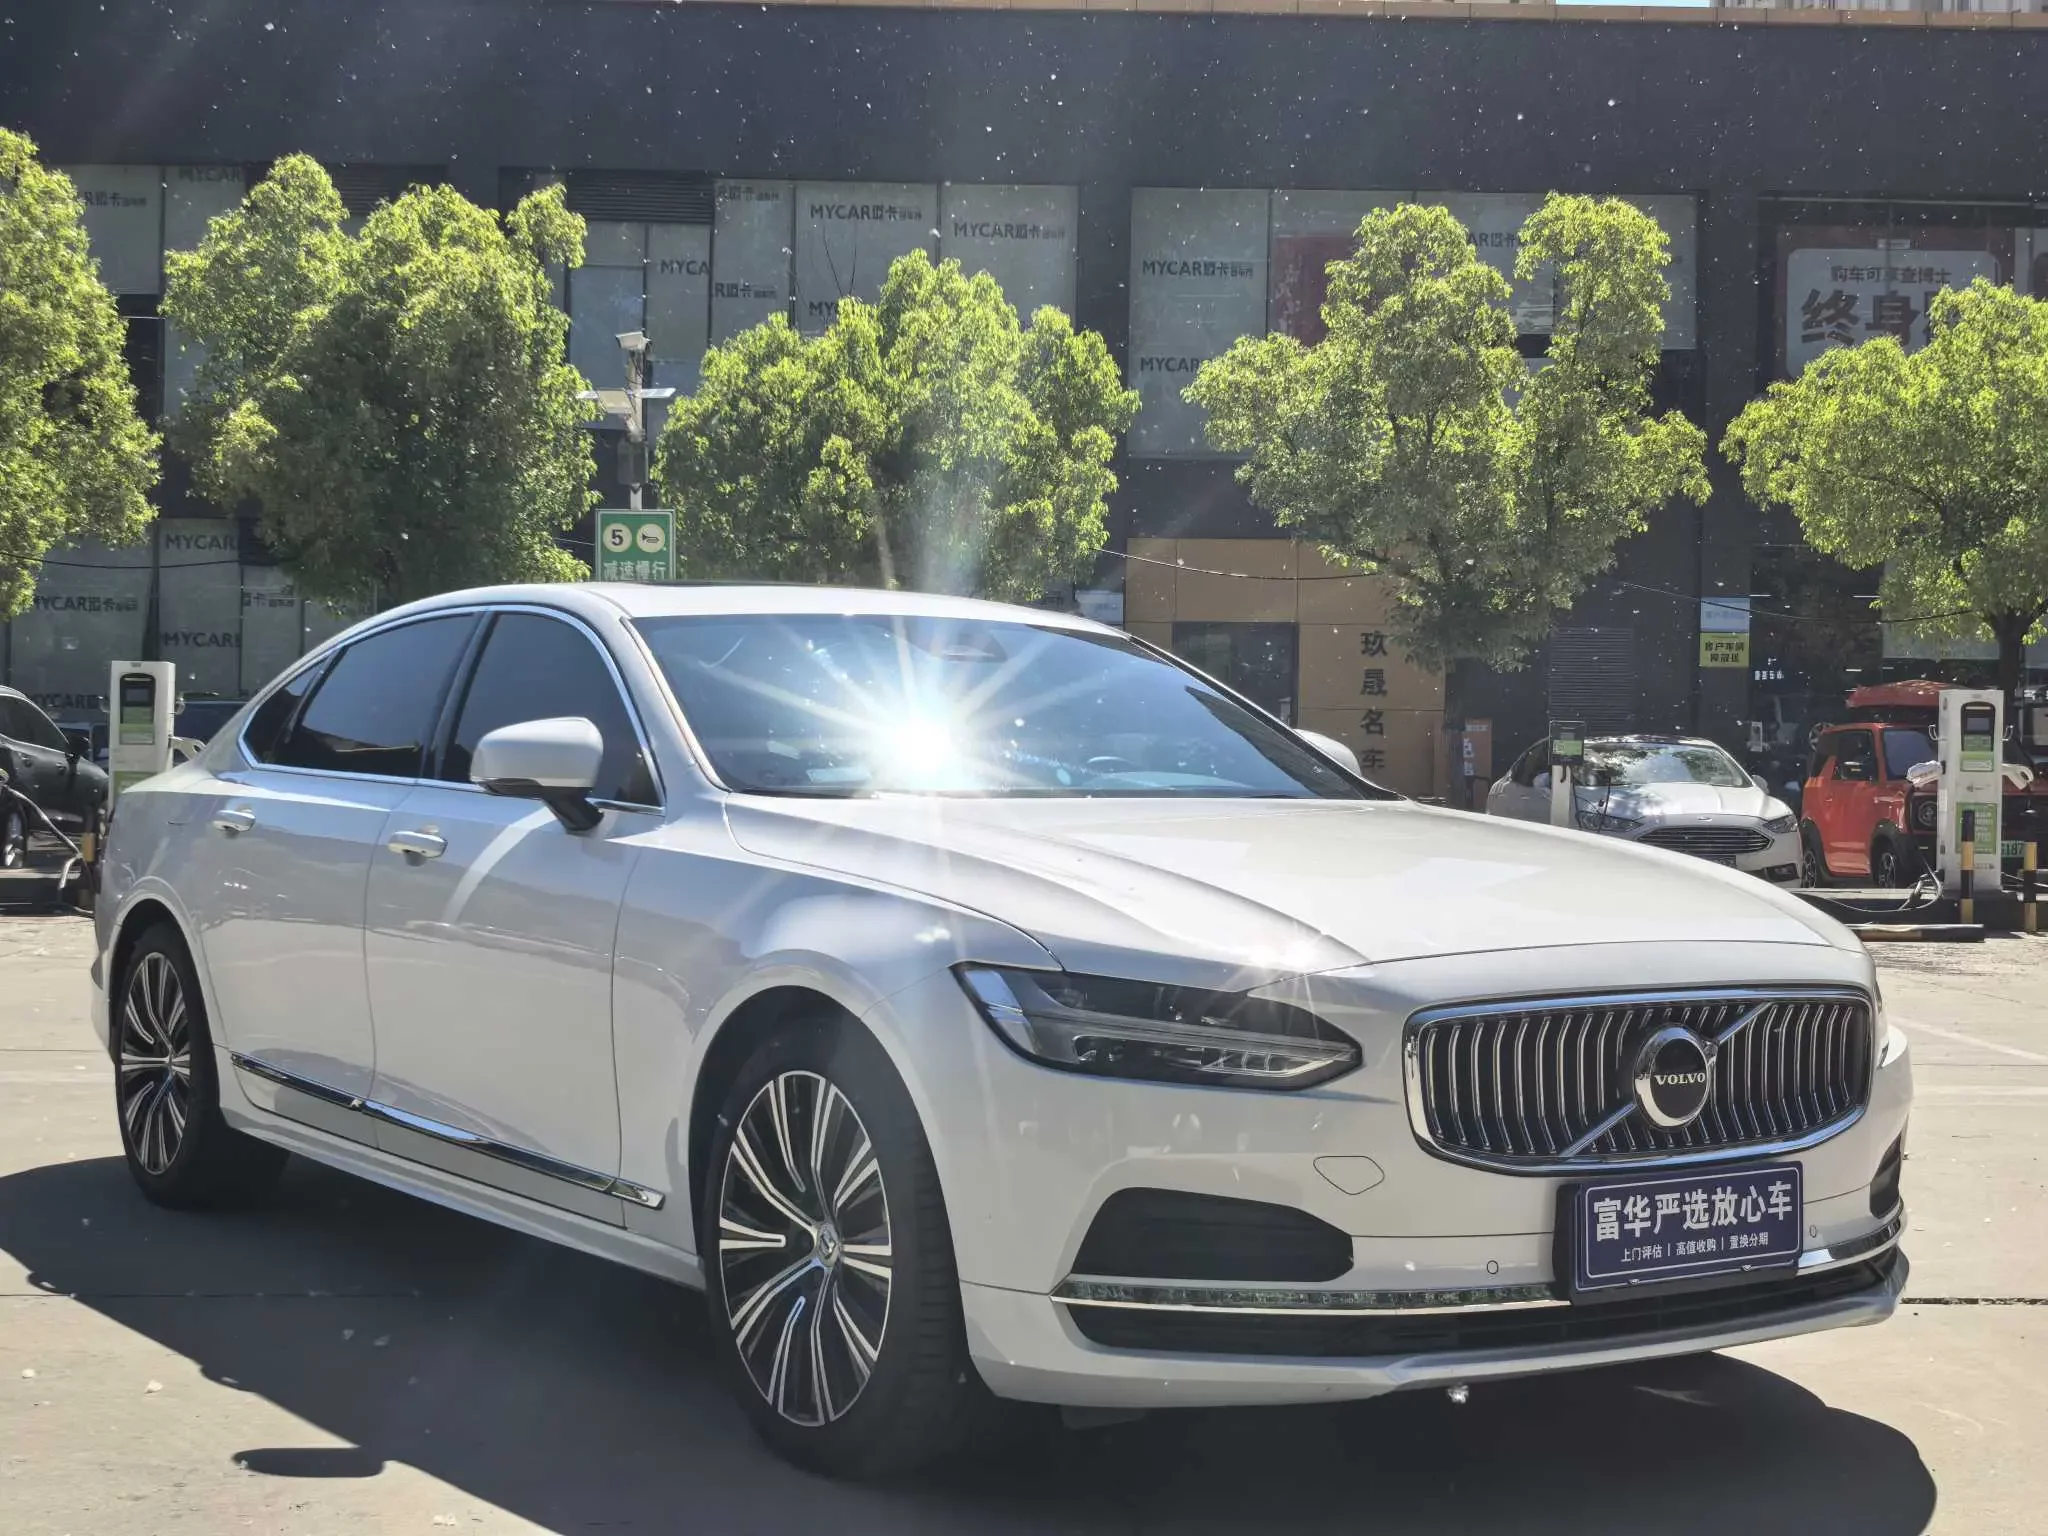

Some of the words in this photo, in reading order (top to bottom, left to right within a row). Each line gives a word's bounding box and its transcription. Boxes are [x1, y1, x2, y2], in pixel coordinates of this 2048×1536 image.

[611, 529, 624, 546] 5
[1654, 1072, 1706, 1086] VOLVO
[1593, 1180, 1793, 1241] 富华严选放心车
[1621, 1244, 1663, 1263] 上门评估
[1676, 1238, 1717, 1257] 高值收购
[1729, 1231, 1769, 1250] 置换分期
